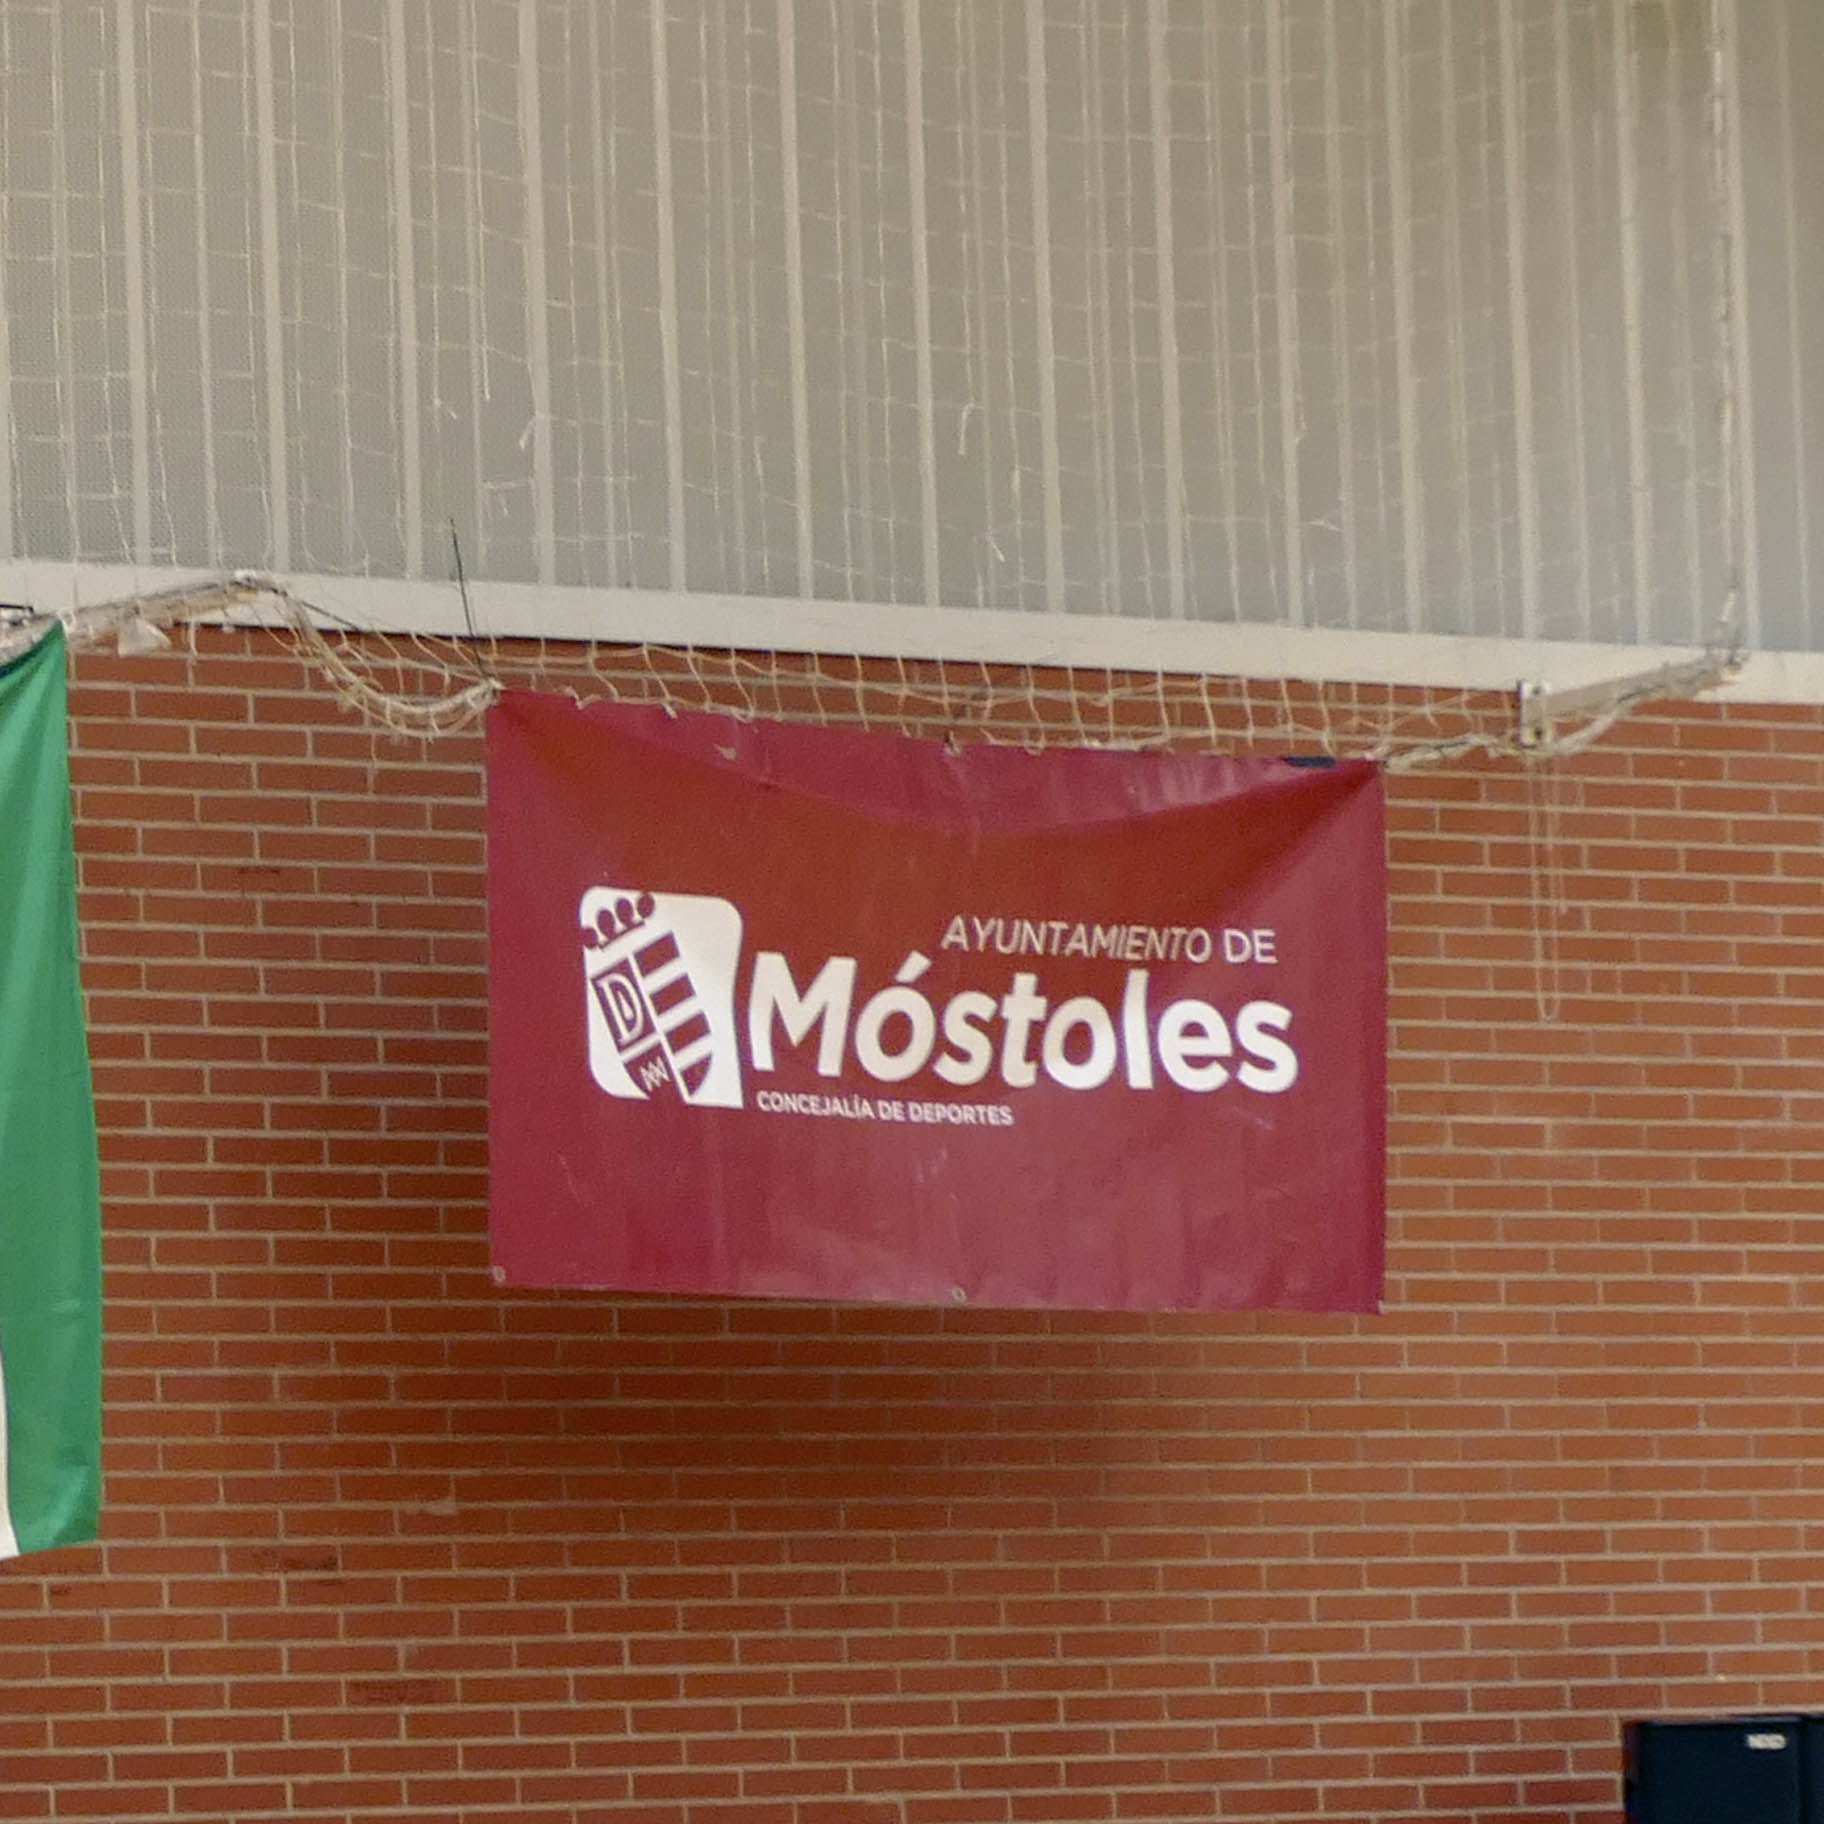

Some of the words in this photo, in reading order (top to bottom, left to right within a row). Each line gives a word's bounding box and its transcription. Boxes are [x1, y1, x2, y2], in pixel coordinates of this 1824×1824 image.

[940, 914, 1212, 963] AYUNTAMIENTO
[1222, 928, 1279, 964] DE
[750, 949, 1297, 1093] Móstoles
[756, 1090, 876, 1120] CONCEJALÍA
[877, 1099, 904, 1122] DE
[908, 1101, 1015, 1127] DEPORTES
